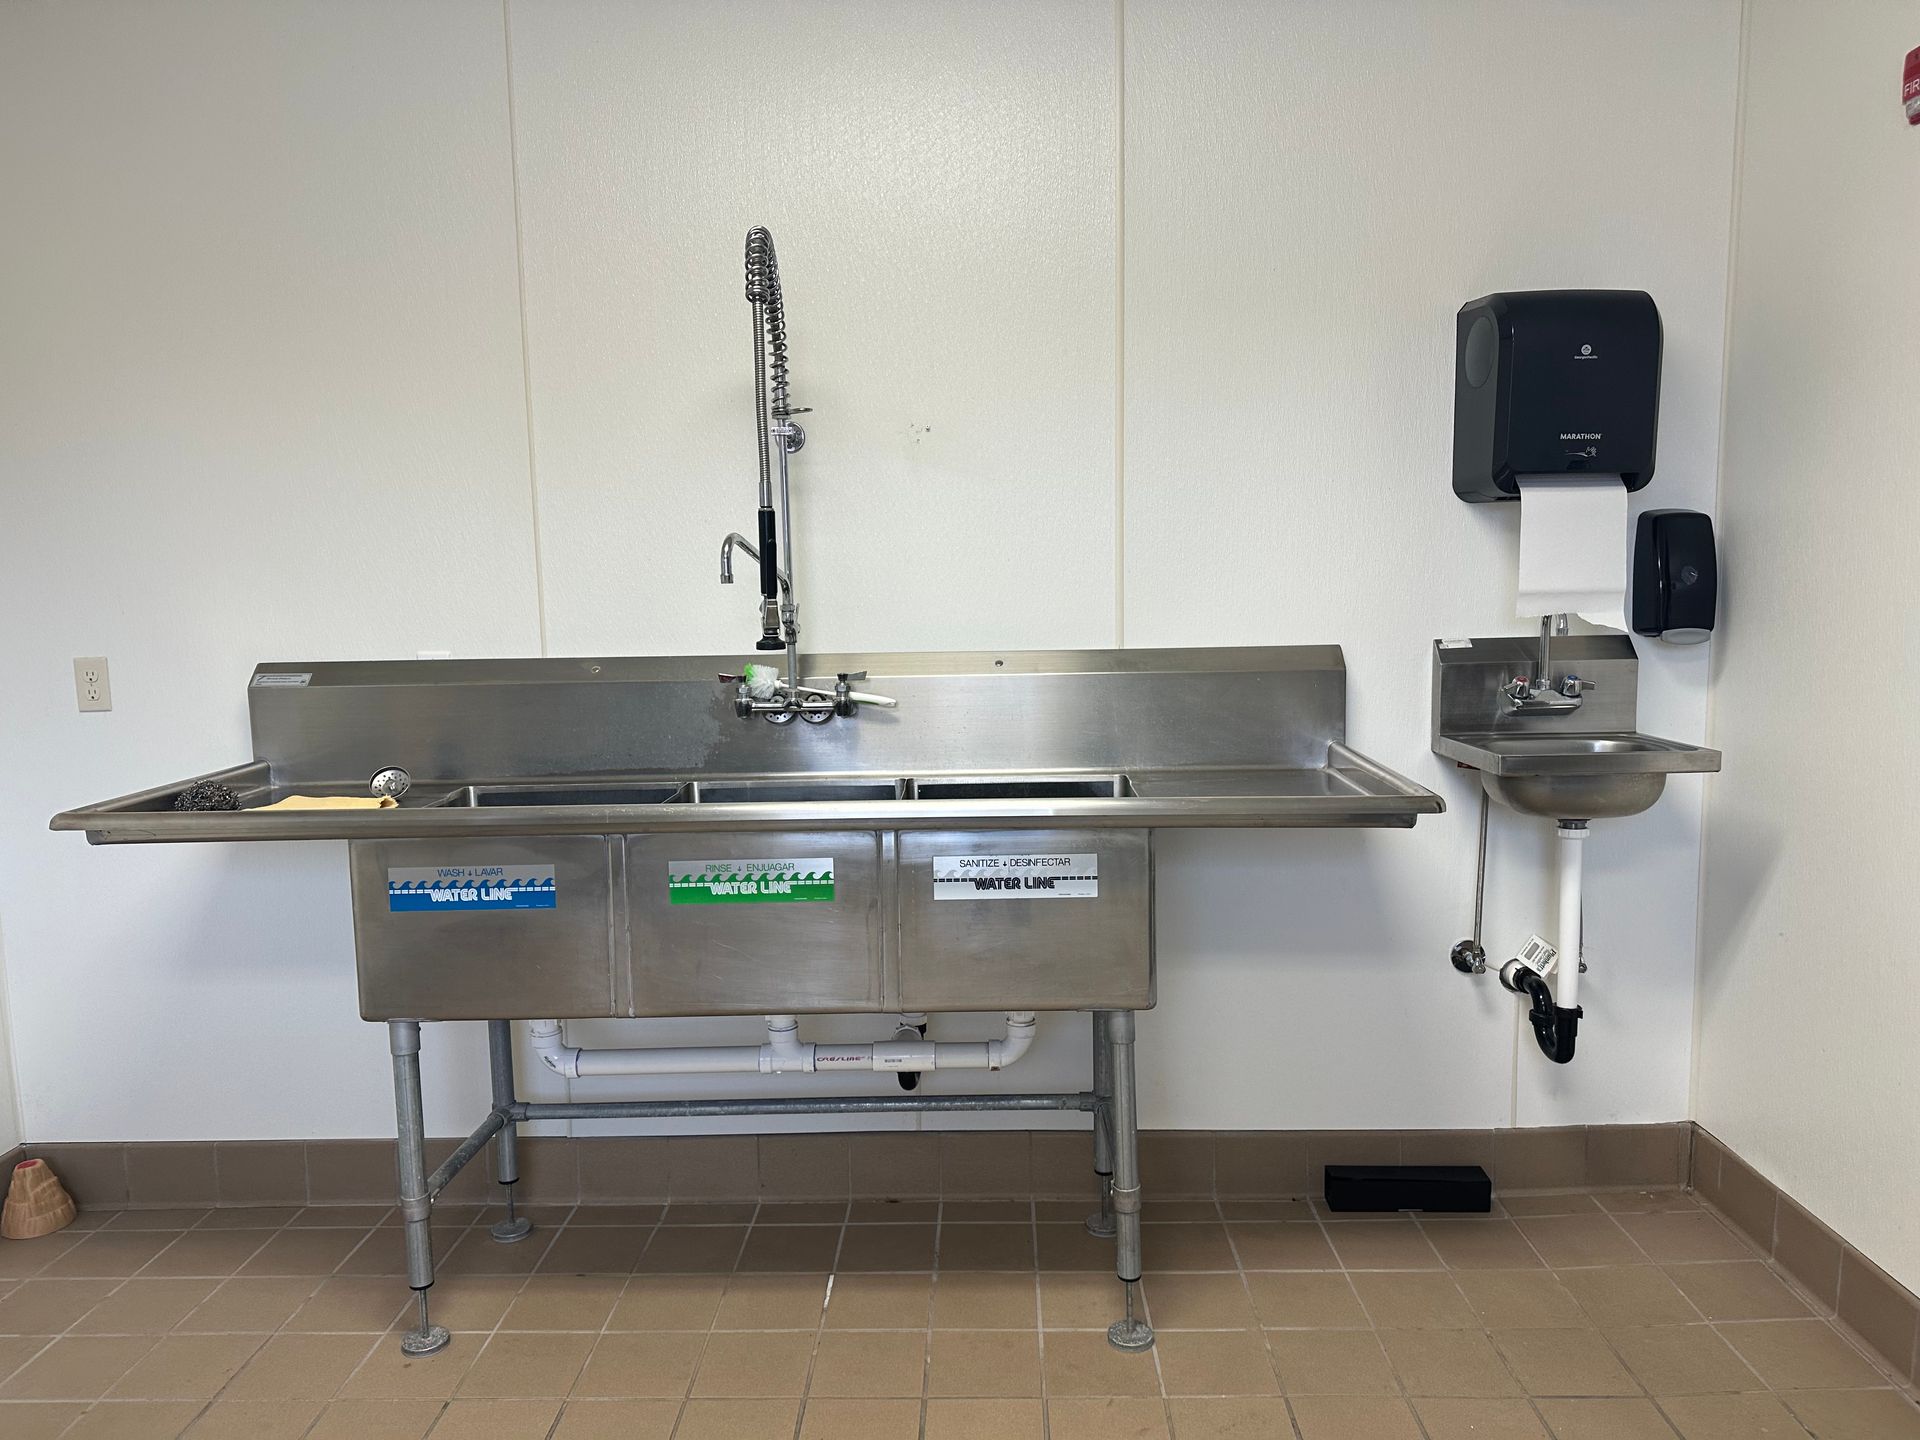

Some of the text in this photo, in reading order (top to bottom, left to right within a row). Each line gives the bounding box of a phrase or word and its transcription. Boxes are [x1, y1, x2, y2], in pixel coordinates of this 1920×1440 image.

[1904, 79, 1920, 97] FIR
[705, 863, 795, 873] RINSE ENJUAGAR
[959, 858, 1071, 868] SANITIZE DESINFECTAR
[437, 868, 504, 877] WASH LAVAR
[709, 881, 792, 895] WATER LINE
[973, 877, 1056, 891] WATER LINE
[429, 888, 513, 902] WATER LINE
